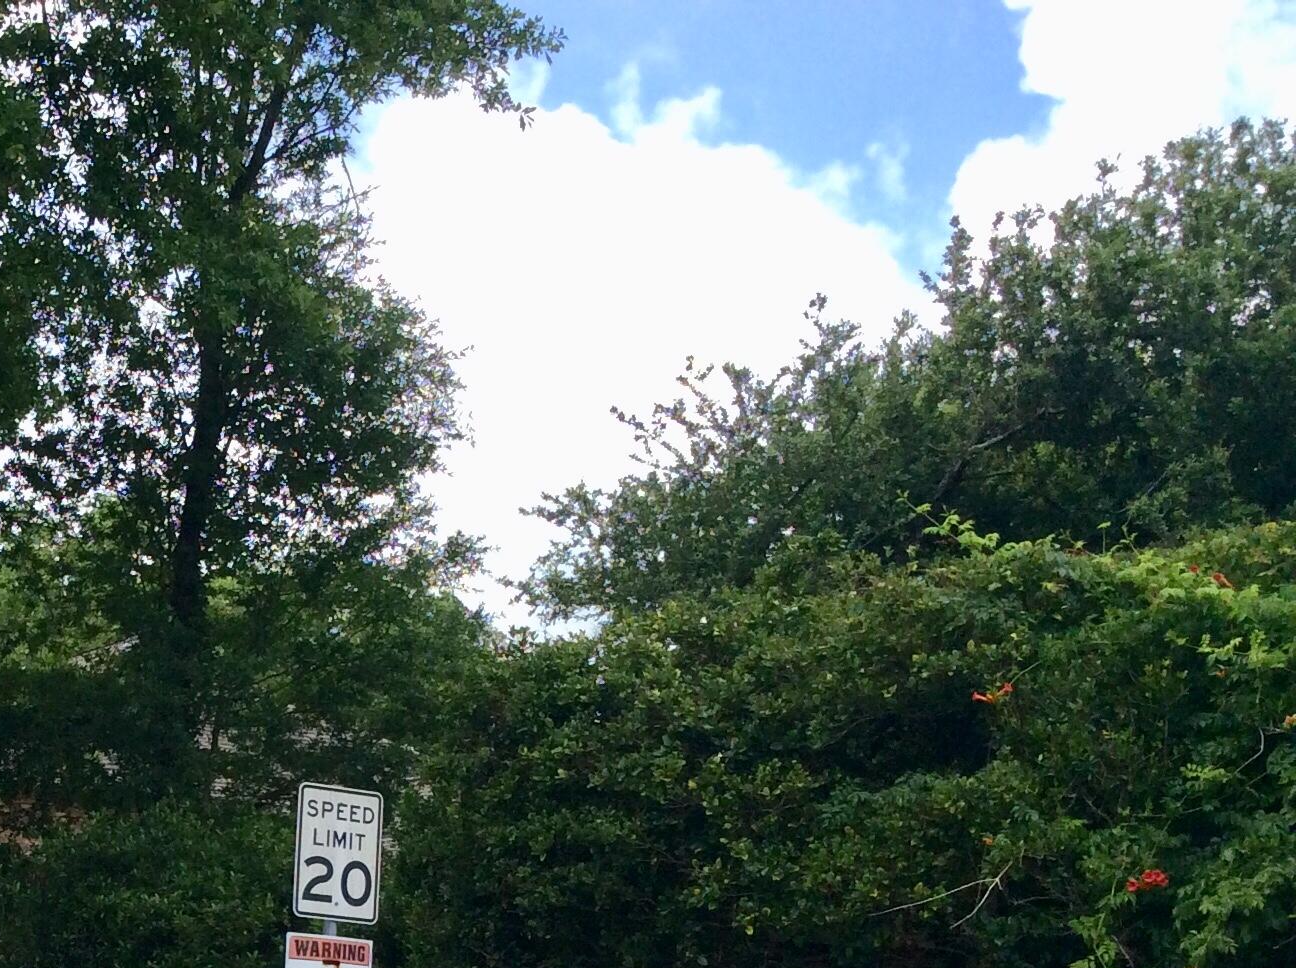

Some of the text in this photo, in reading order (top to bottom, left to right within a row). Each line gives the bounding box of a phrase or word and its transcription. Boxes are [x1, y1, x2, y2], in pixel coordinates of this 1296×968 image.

[307, 799, 375, 824] SPEED
[312, 828, 366, 851] LIMIT
[302, 855, 372, 907] 20
[294, 939, 366, 963] WARNING
